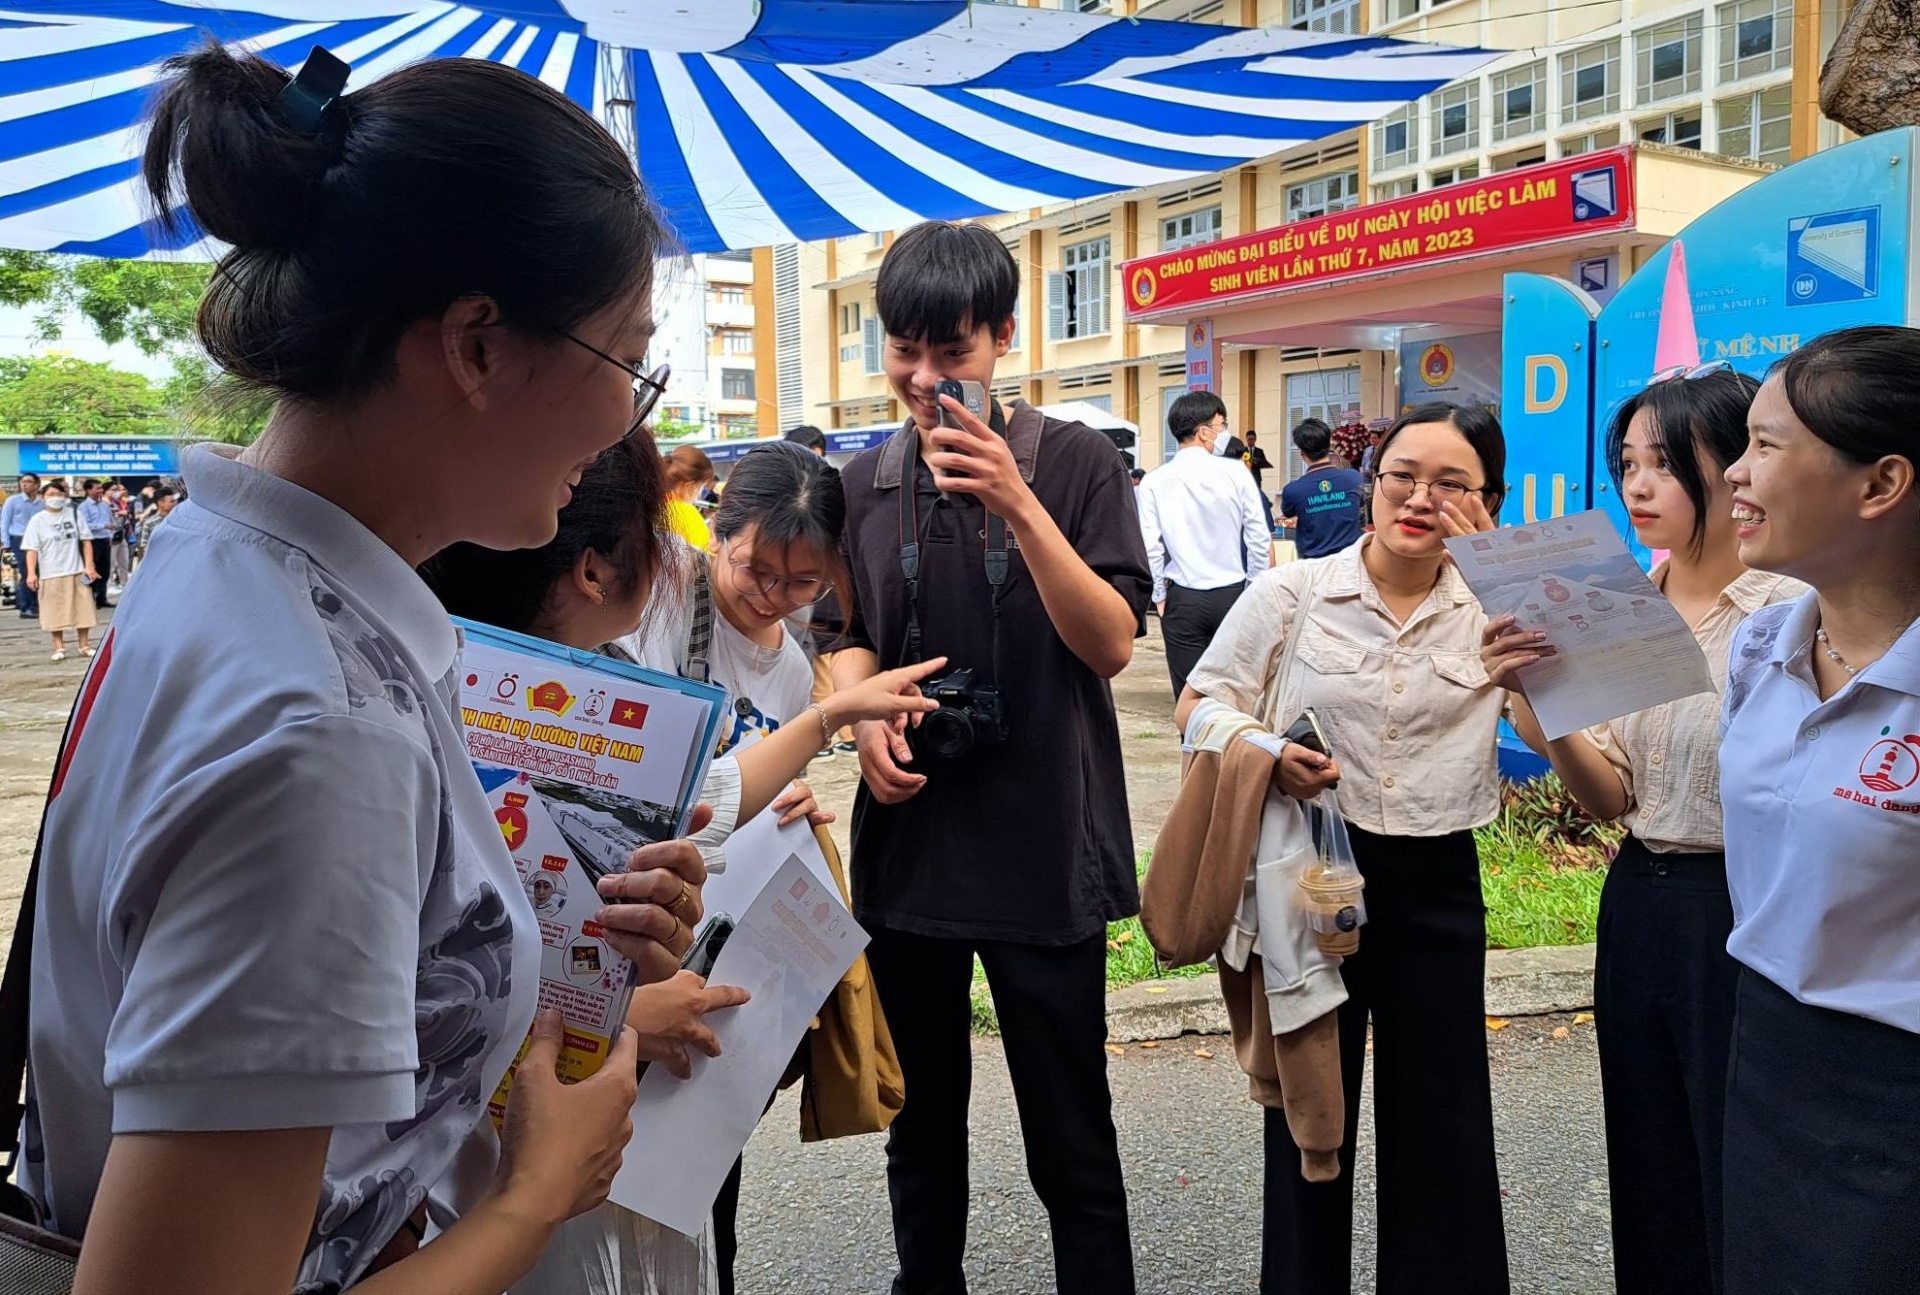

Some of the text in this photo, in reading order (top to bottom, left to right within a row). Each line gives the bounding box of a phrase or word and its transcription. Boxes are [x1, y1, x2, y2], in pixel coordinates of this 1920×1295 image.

[1159, 178, 1557, 279] CHÀO MỪNG ĐẠI BIỂU VỀ DỰ NGÀY HỘI VIỆC LÀM
[1209, 227, 1475, 293] SINH VIÊN LẦN THỨ 7, NĂM 2023
[1713, 332, 1801, 360] MỆNH
[477, 711, 512, 734] NIÊN
[510, 719, 532, 741] HỌ
[530, 723, 578, 749] DƯƠNG
[579, 733, 611, 757] VIỆT
[608, 739, 644, 764] NAM
[547, 749, 597, 770] MUSASHINO
[568, 767, 576, 779] 1
[1833, 786, 1920, 814] ms hai dang
